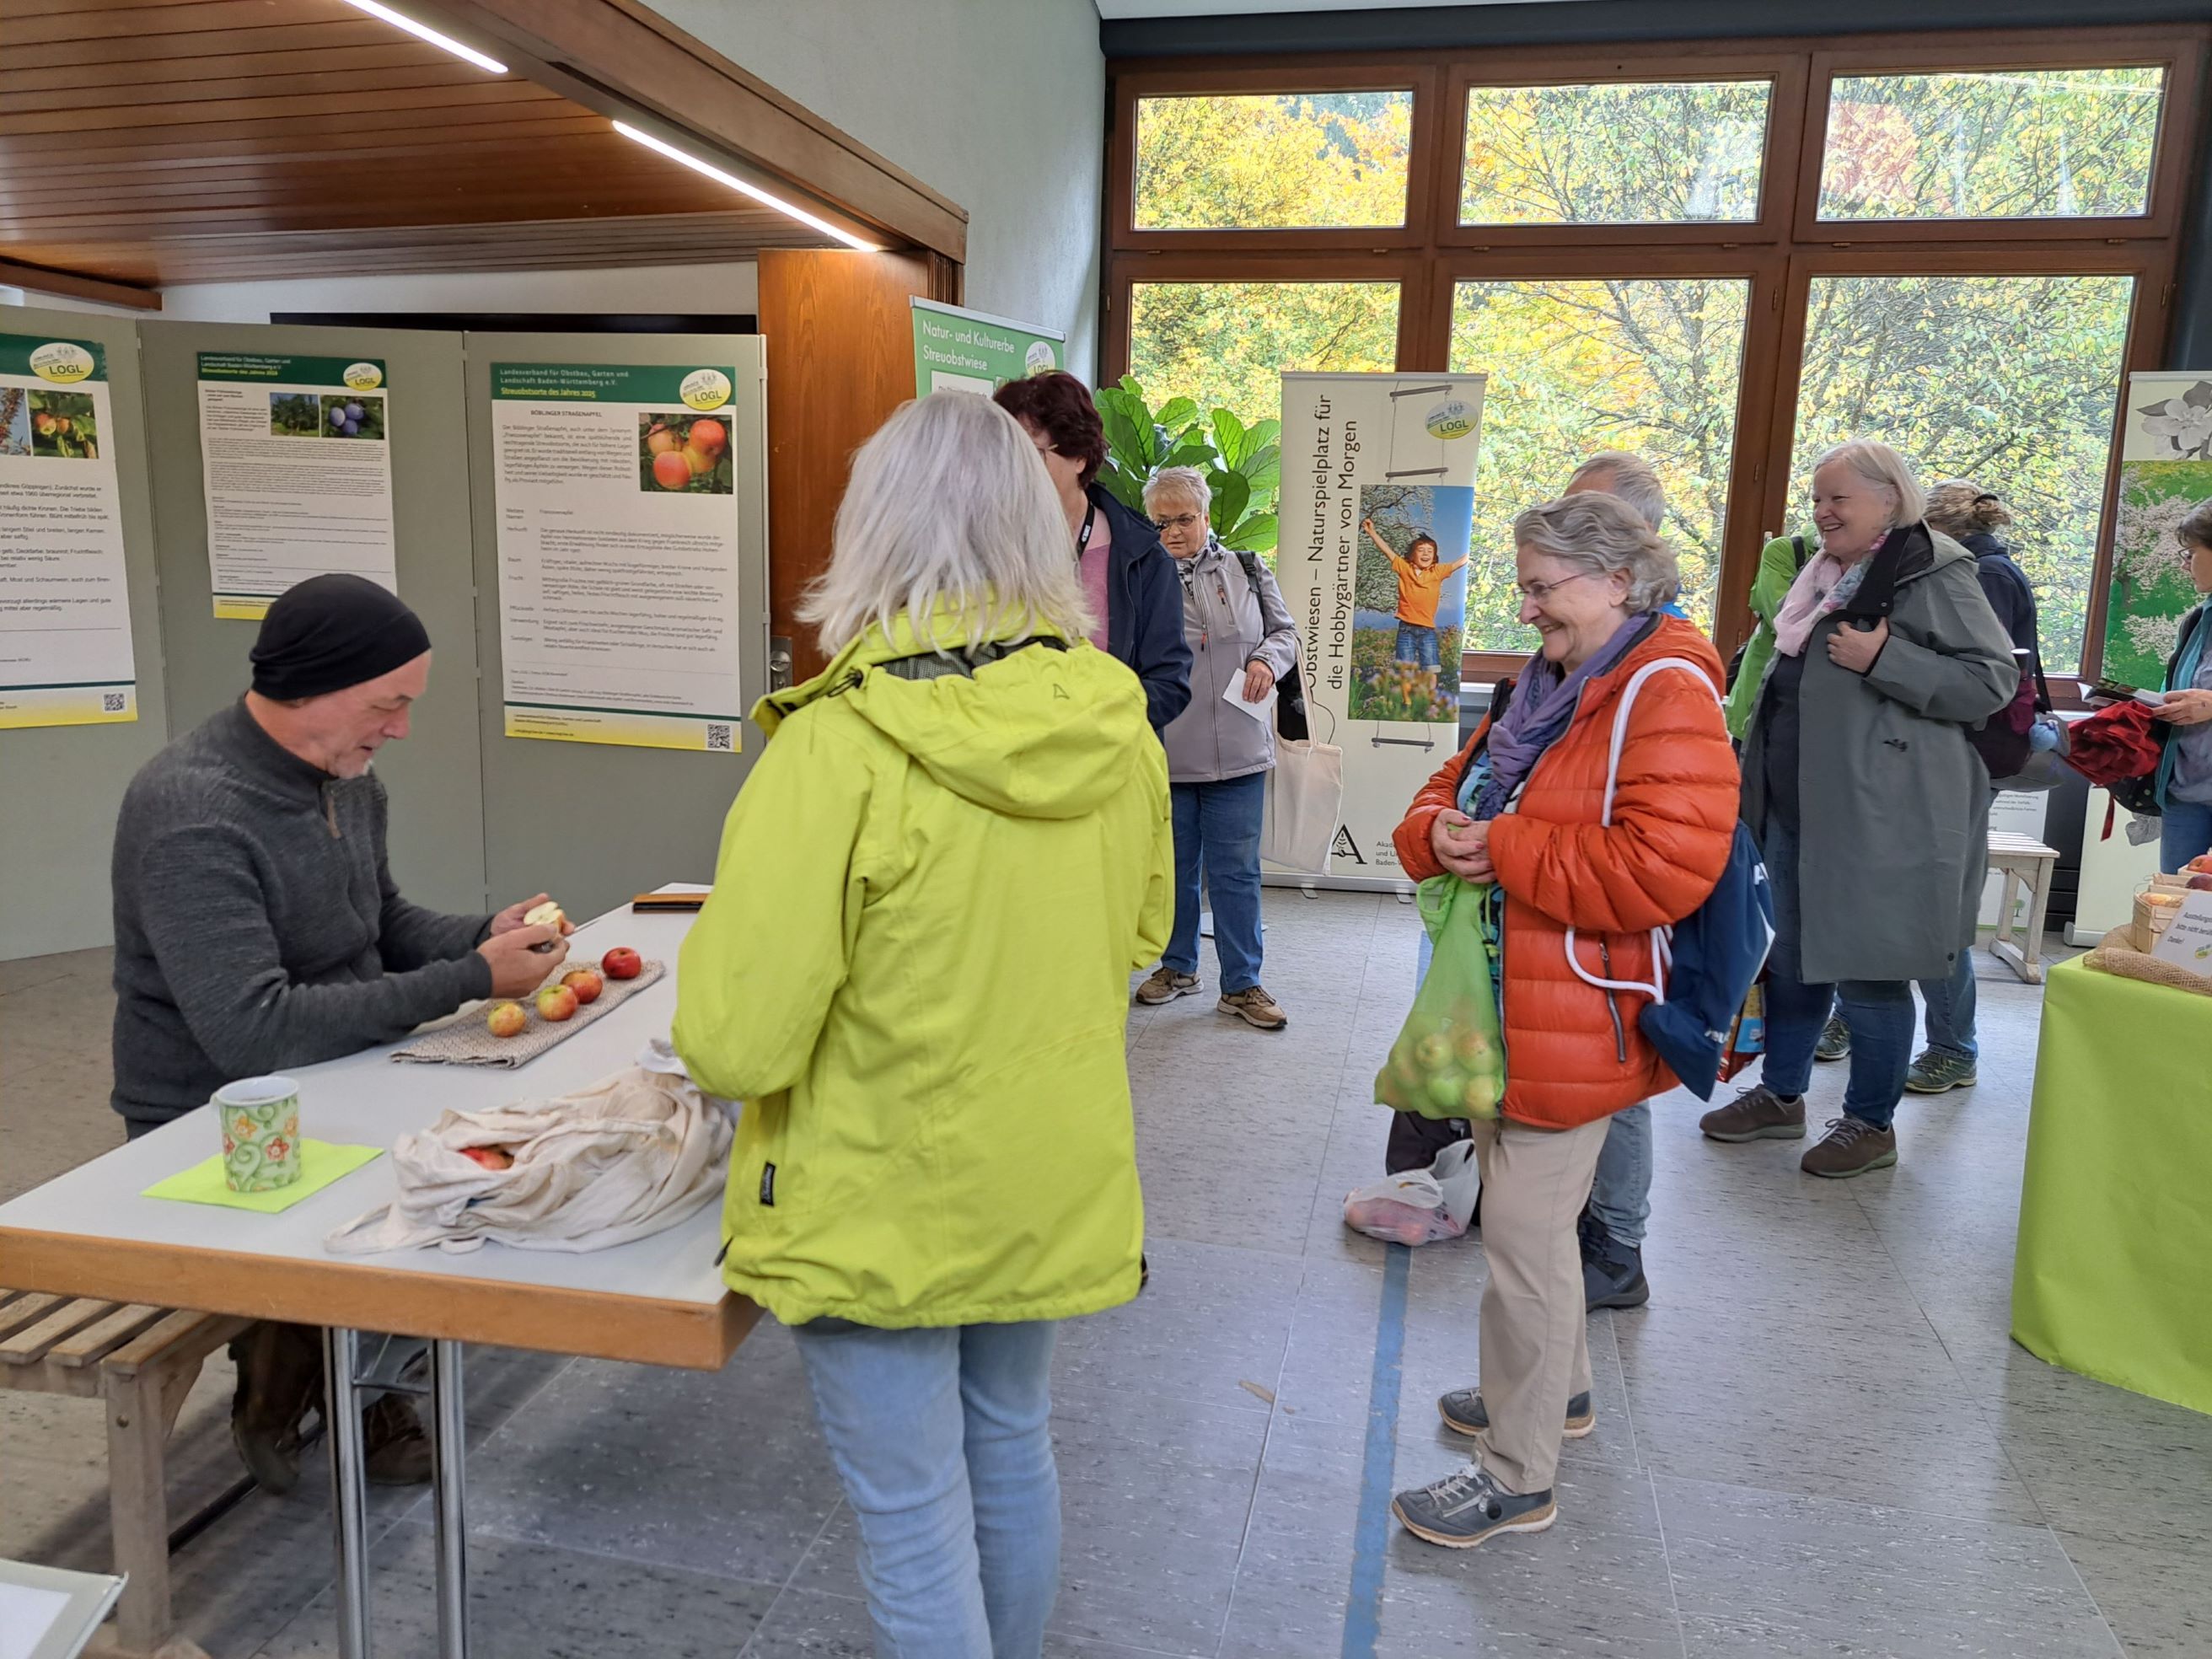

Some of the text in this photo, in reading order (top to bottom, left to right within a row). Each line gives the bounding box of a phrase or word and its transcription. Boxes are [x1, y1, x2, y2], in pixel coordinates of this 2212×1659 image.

[923, 319, 1015, 353] Natur- und Kulturerbe
[49, 364, 84, 376] LOGL
[923, 344, 987, 370] Streuobstwiese
[355, 378, 376, 386] LOGL
[695, 390, 722, 402] LOGL
[1314, 395, 1331, 421] für
[1440, 420, 1468, 432] LOGL
[1307, 427, 1333, 561] Naturspielplatz
[1327, 421, 1361, 690] die Hobbygärtner von Morgen
